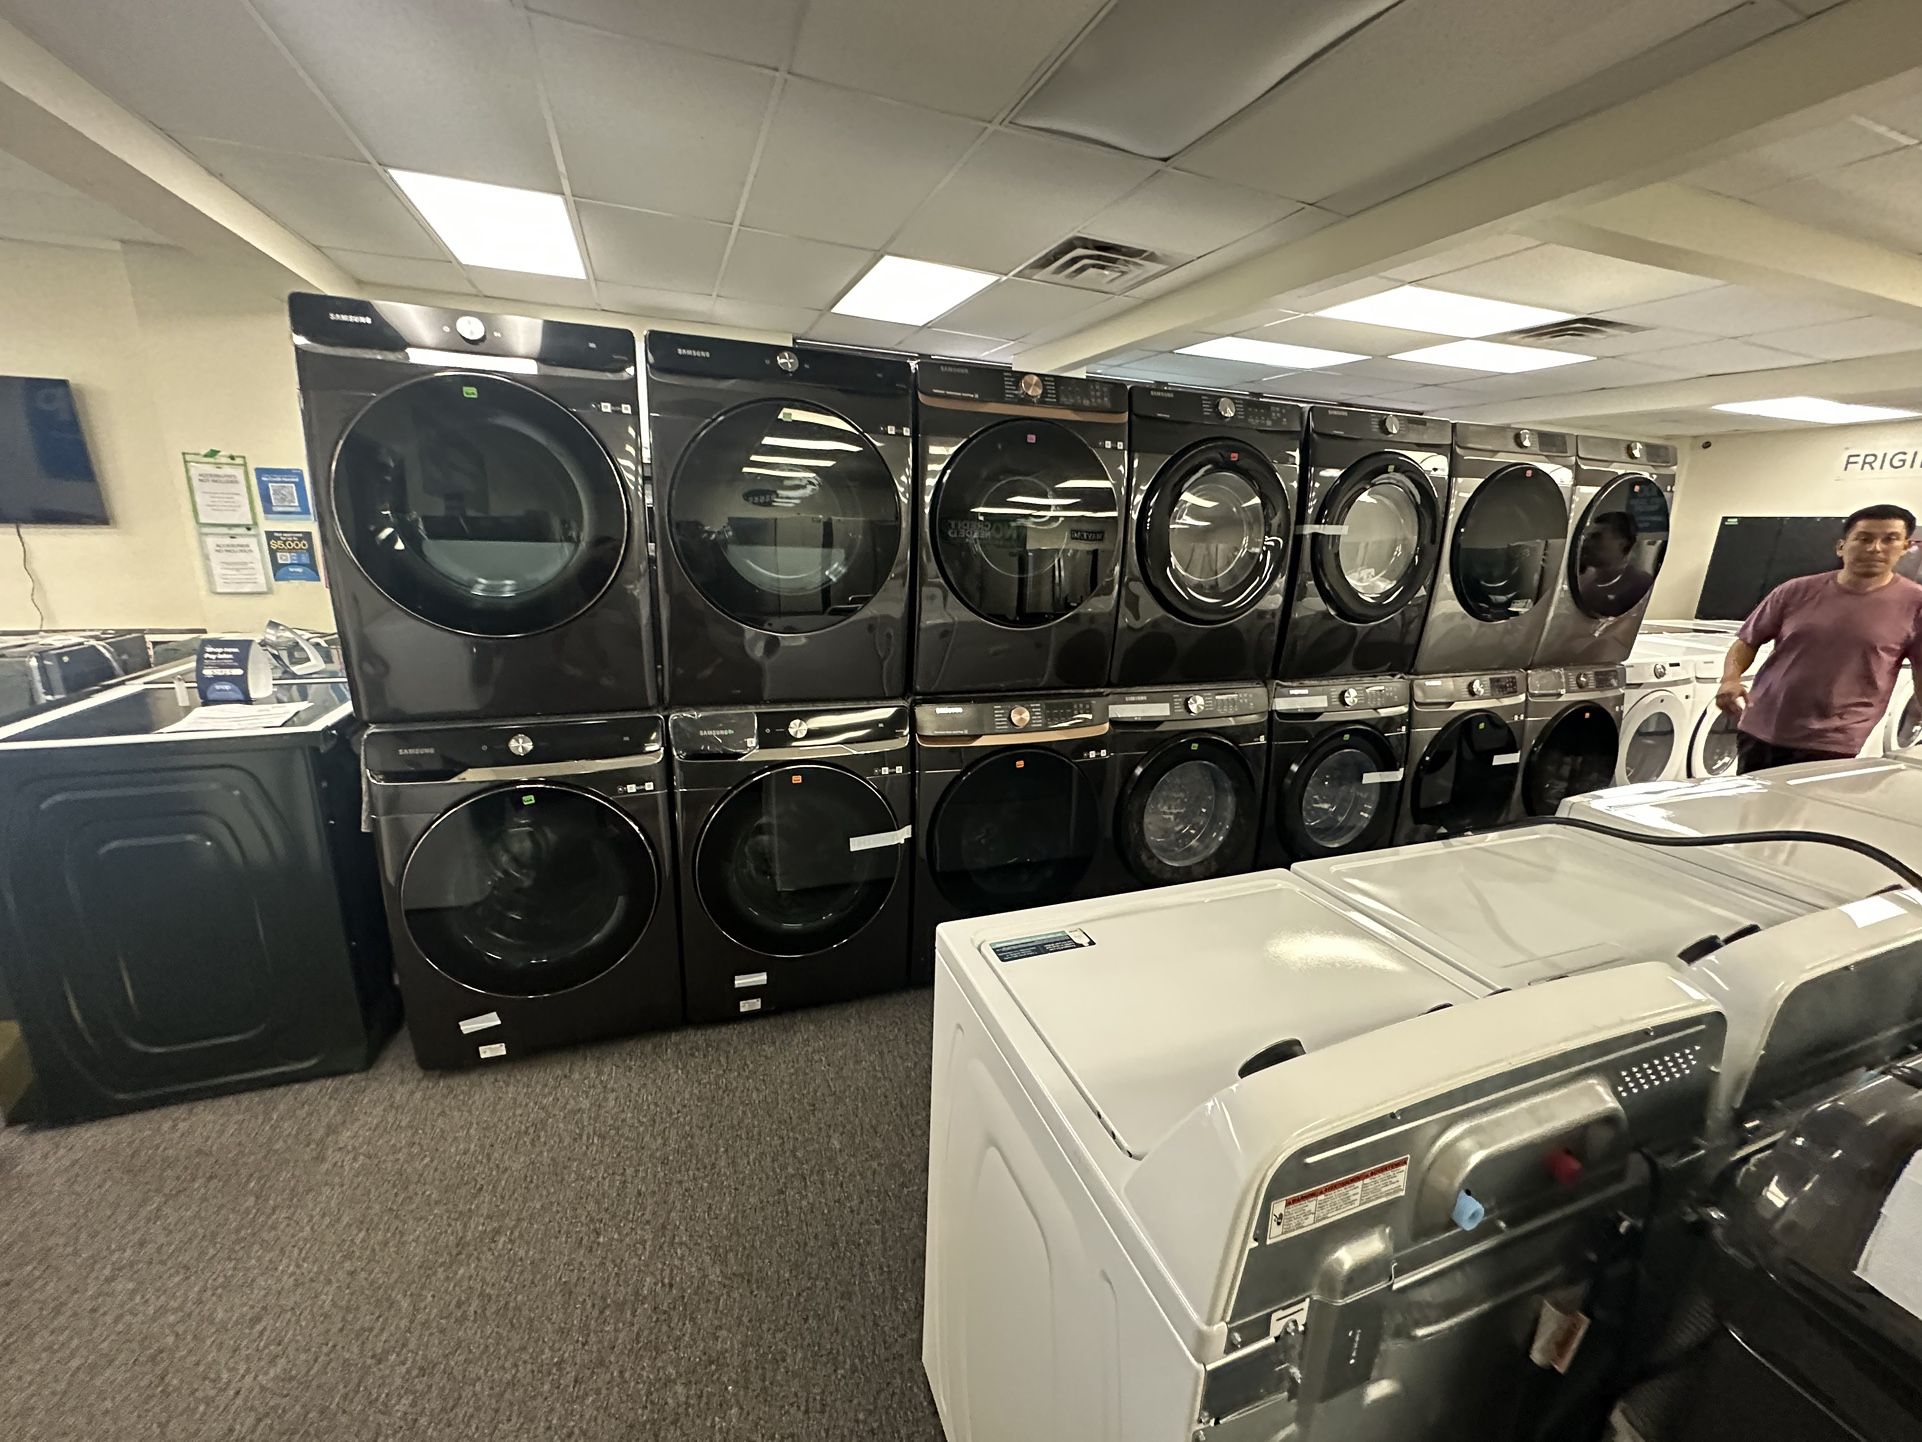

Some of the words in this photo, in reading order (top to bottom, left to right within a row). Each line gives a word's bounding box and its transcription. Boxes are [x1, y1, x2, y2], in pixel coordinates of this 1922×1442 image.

[329, 312, 372, 324] SAMSUNG
[677, 348, 710, 358] SAMSUNG
[1843, 450, 1922, 471] FRIGI
